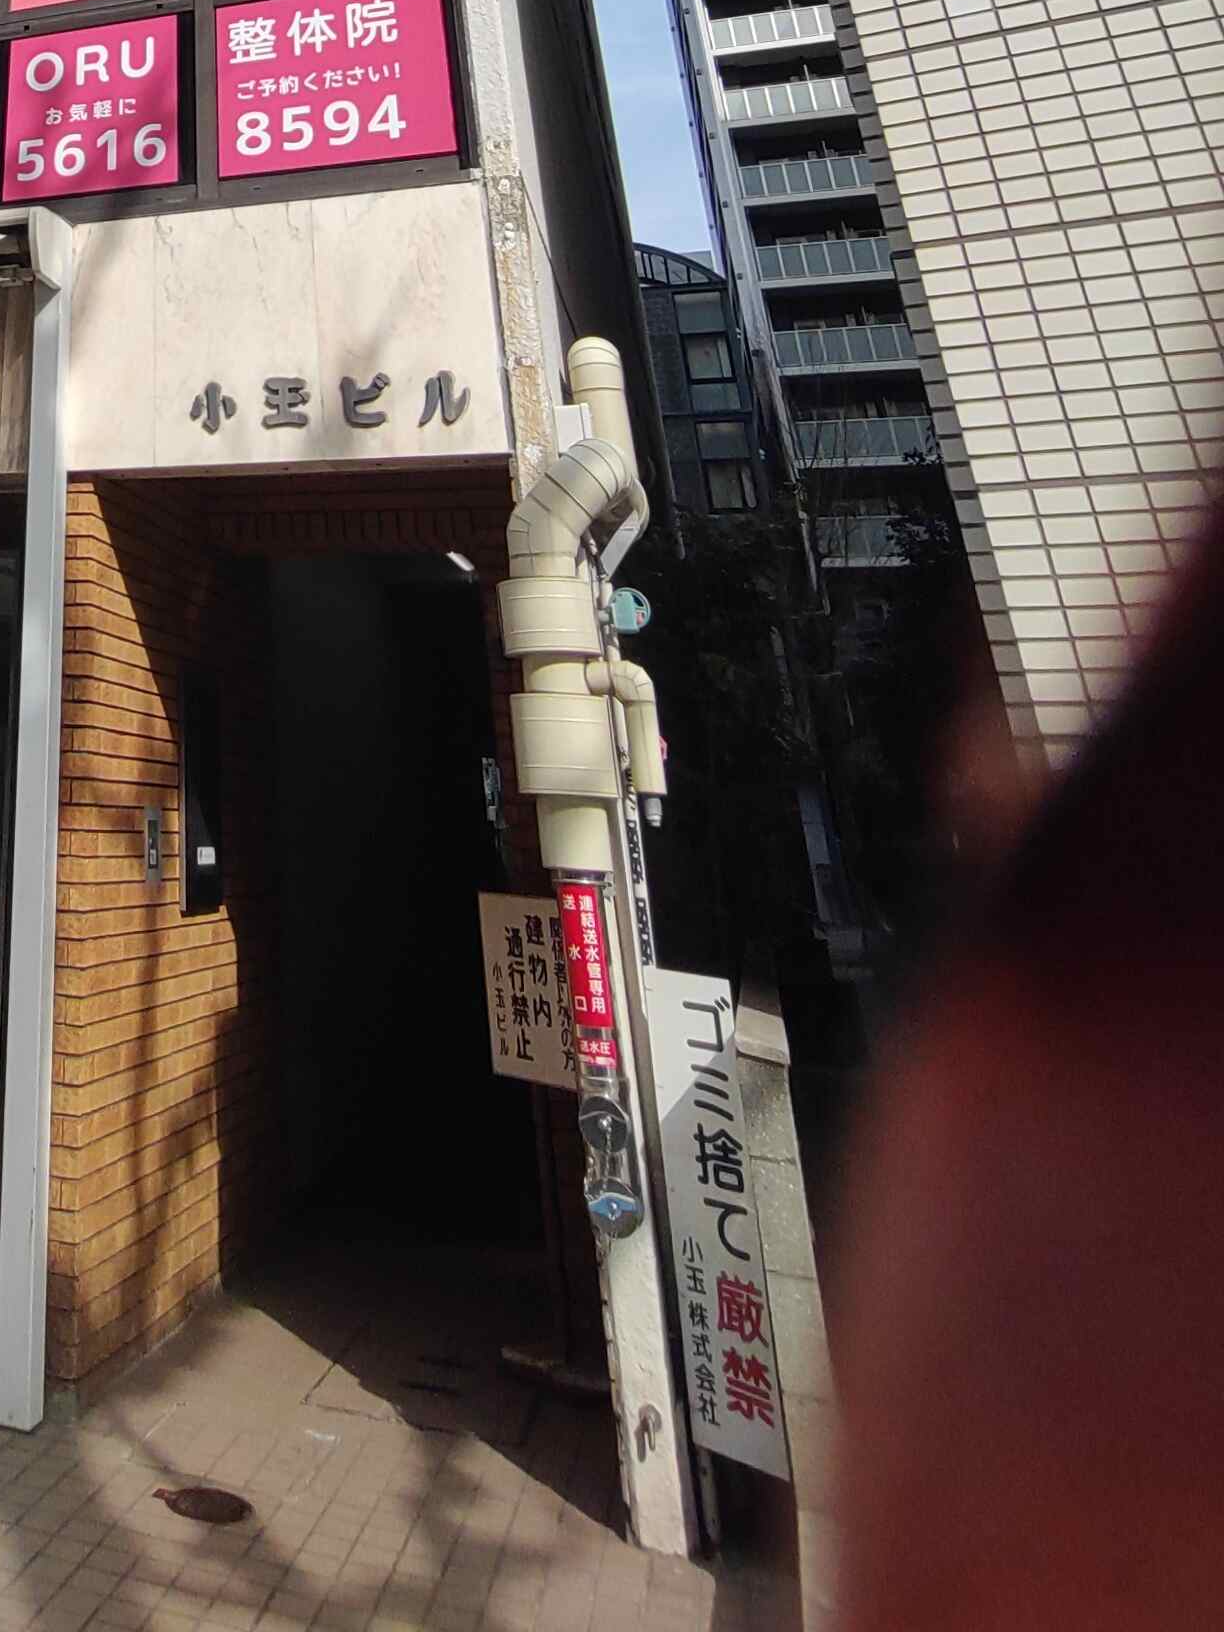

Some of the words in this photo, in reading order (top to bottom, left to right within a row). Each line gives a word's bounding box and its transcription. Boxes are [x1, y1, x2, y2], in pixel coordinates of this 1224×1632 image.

[25, 36, 156, 93] ORU
[45, 98, 137, 125] お気軽に
[235, 94, 407, 156] 8594
[16, 123, 168, 182] 5616
[504, 926, 534, 1062] 通行禁止
[525, 914, 552, 1028] 建物内
[681, 1235, 720, 1428] 小玉株式会社
